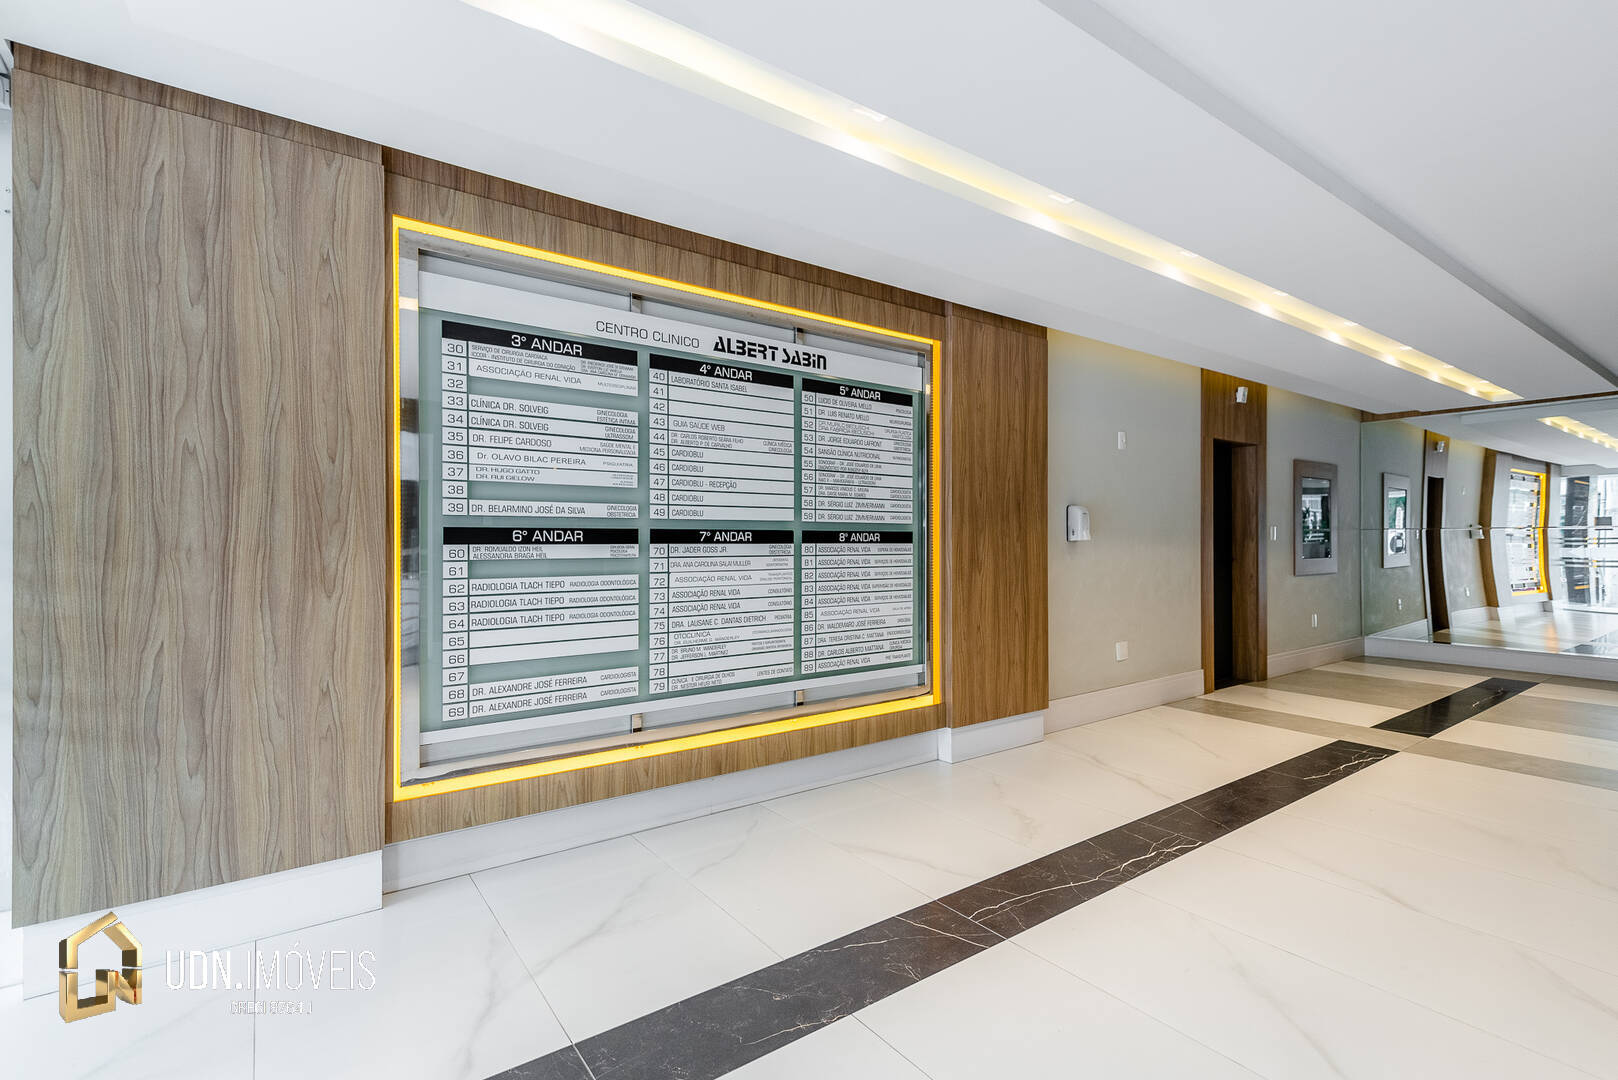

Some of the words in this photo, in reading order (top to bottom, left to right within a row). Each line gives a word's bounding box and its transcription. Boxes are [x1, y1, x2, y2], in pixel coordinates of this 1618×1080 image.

[596, 321, 648, 339] CENTRO
[652, 330, 699, 348] CLINICO
[447, 344, 464, 353] 30
[531, 337, 582, 356] ANDAR
[714, 335, 778, 361] ALBERT
[447, 362, 462, 370] 31
[714, 366, 752, 381] ANDAR
[447, 380, 464, 388] 32
[671, 377, 710, 387] LABORATÓRIO
[712, 382, 729, 390] SANTA
[730, 384, 747, 392] ISABEL
[851, 388, 880, 400] ANDAR
[447, 397, 464, 405] 33
[471, 399, 500, 409] CLÍNICA
[503, 403, 516, 411] DR.
[519, 404, 548, 414] SOLVEIG
[447, 415, 464, 423] 34
[471, 416, 500, 427] CLÍNICA
[503, 420, 516, 428] DR.
[519, 421, 548, 431] SOLVEIG
[447, 432, 464, 441] 35
[472, 434, 486, 442] DR.
[490, 436, 513, 444] FELIPE
[516, 438, 552, 447] CARDOSO
[447, 451, 464, 459] 36
[672, 450, 704, 458] CARDIOBLU
[551, 457, 586, 465] PEREIRA
[447, 468, 464, 476] 37
[709, 480, 737, 489] RECEPÇÃO
[447, 486, 464, 494] 38
[447, 504, 464, 512] 39
[535, 505, 554, 514] JOSÉ
[532, 530, 583, 541] ANDAR
[714, 532, 752, 541] ANDAR
[851, 533, 880, 541] ANDAR
[449, 550, 464, 558] 60
[449, 585, 464, 593] 62
[472, 583, 518, 591] RADIOLOGIA
[600, 578, 636, 586] ODONTOLÓGICA
[449, 603, 464, 611] 63
[471, 599, 518, 608] RADIOLOGIA
[672, 604, 708, 612] ASSOCIAÇÃO
[472, 617, 518, 626] RADIOLOGIA
[520, 615, 543, 623] TLACH
[544, 614, 565, 622] TIEPO
[569, 612, 598, 620] RADIOLOGIA
[600, 610, 636, 618] ODONTOLÓGICA
[449, 620, 464, 628] 64
[449, 637, 464, 646] 65
[449, 655, 464, 664] 66
[472, 688, 486, 696] DR.
[489, 683, 532, 695] ALEXANDRE
[555, 677, 587, 687] FERREIRA
[600, 672, 636, 680] CARDIOLOGISTA
[449, 690, 464, 699] 68
[472, 705, 486, 714] DR.
[489, 699, 532, 712] ALEXANDRE
[555, 693, 587, 704] FERREIRA
[600, 688, 636, 697] CARDIOLOGISTA
[449, 708, 464, 716] 69
